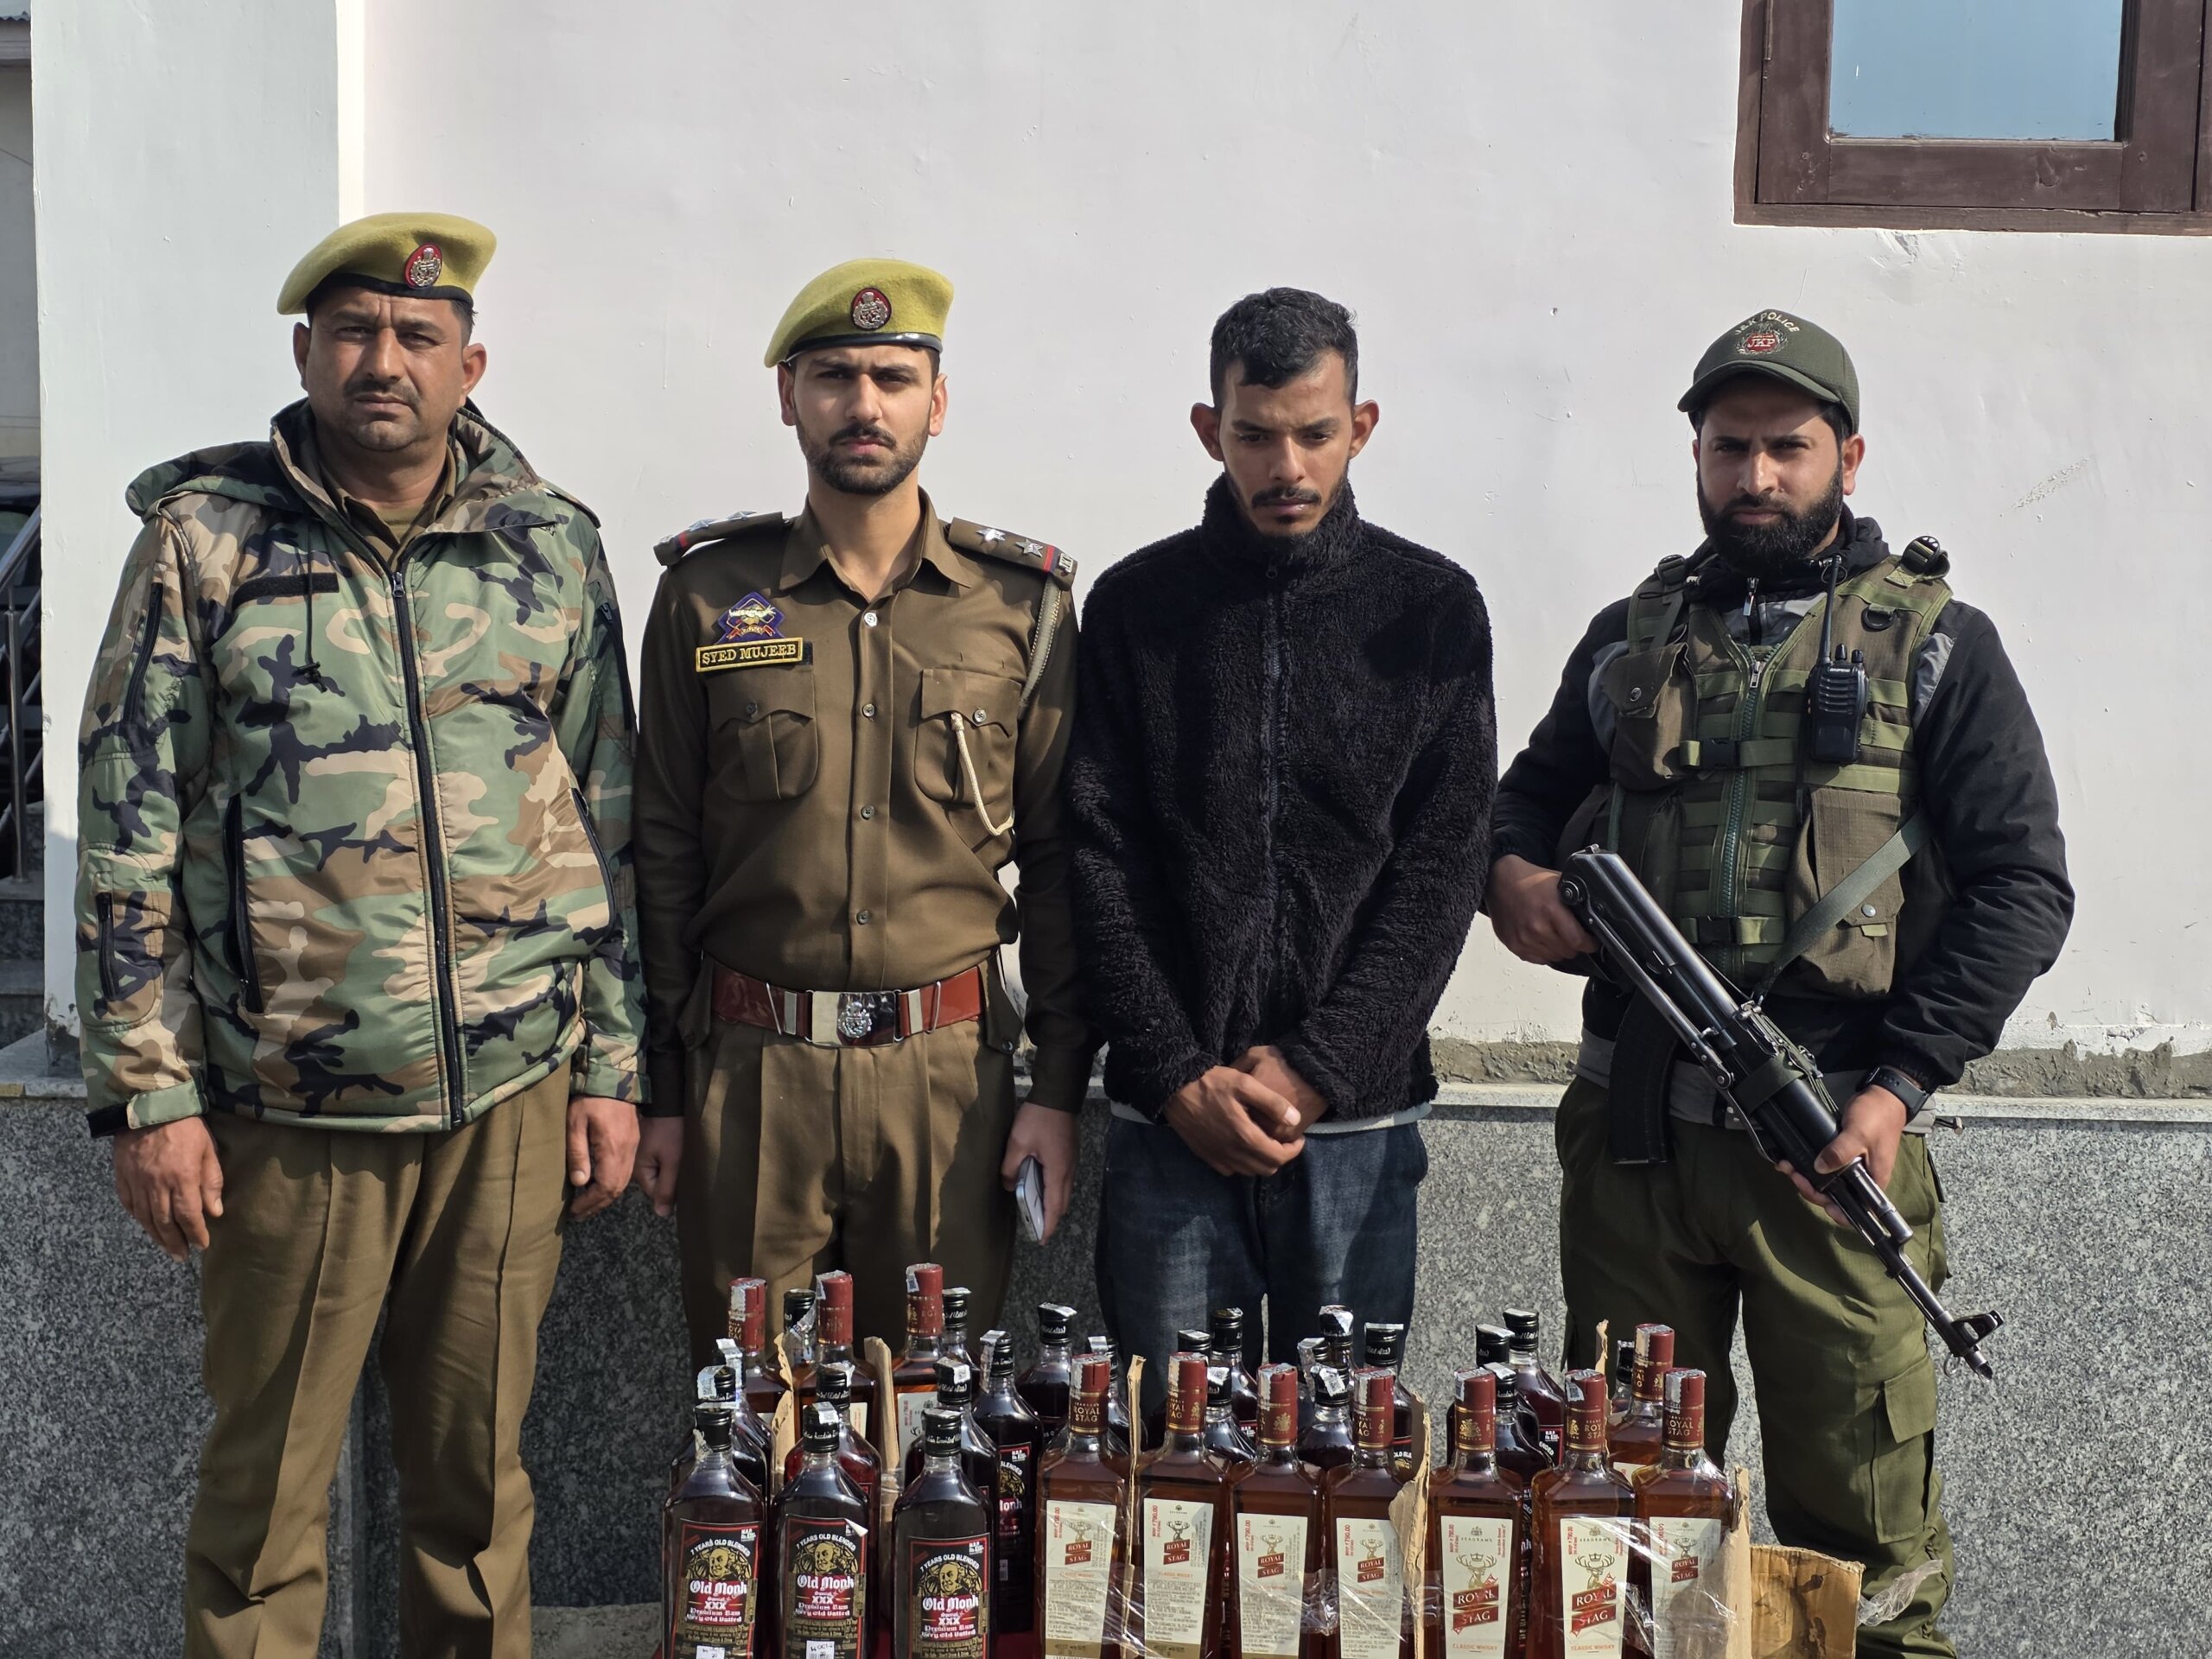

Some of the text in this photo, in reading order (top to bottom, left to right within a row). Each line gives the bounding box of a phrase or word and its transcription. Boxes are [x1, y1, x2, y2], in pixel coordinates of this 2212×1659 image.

[1760, 312, 1800, 333] POLICE
[1747, 338, 1775, 347] JKP
[702, 644, 796, 665] SYED MUJEEB
[695, 1539, 713, 1552] YEARS
[728, 1541, 750, 1556] BLENDED
[800, 1534, 817, 1547] YEARS
[832, 1535, 856, 1551] BLENDED
[1068, 1542, 1090, 1551] ROYAL
[1166, 1541, 1187, 1550] ROYAL
[924, 1555, 942, 1569] YEARS
[957, 1554, 979, 1570] BLENDED
[1167, 1554, 1185, 1562] STAG
[1261, 1555, 1281, 1564] ROYAL
[1675, 1560, 1695, 1568] ROYAL
[1262, 1567, 1279, 1575] STAG
[797, 1574, 854, 1591] Old Monk
[690, 1580, 747, 1597] Old Monk
[704, 1601, 726, 1610] XXX
[812, 1595, 834, 1605] XXX
[923, 1595, 979, 1611] Old Monk
[938, 1617, 961, 1625] XXX
[1461, 1611, 1491, 1624] STAG
[1579, 1610, 1608, 1625] STAG
